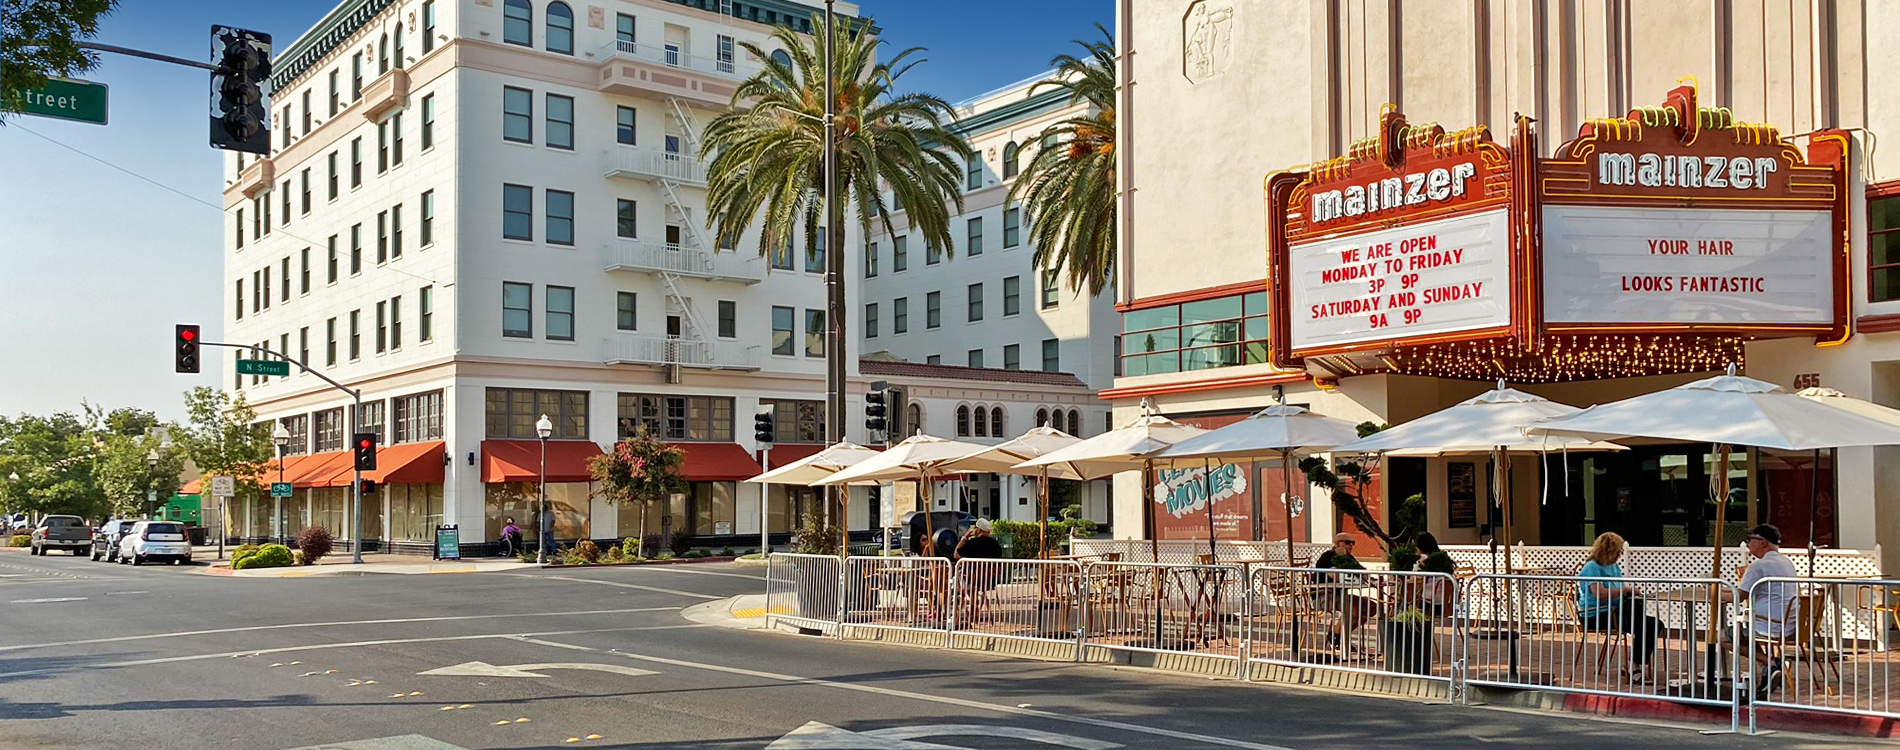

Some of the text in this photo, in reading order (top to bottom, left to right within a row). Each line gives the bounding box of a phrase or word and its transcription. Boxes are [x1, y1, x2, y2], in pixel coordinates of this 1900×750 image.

[1599, 152, 1777, 190] mainzer
[1311, 161, 1475, 223] mainzer
[1341, 235, 1436, 264] WE ARE OPEN
[1648, 239, 1734, 255] YOUR HAIR
[1322, 248, 1464, 284] MONDAY TO FRIDAY
[1369, 273, 1419, 294] 3P 9P
[1622, 275, 1765, 292] LOOKS FANTASTIC
[1311, 282, 1483, 319] SATURDAY AND SUNDAY
[1369, 308, 1422, 329] 9A 9P
[246, 363, 280, 372] N Street
[1793, 373, 1820, 390] 655
[1165, 463, 1236, 514] MOVIES
